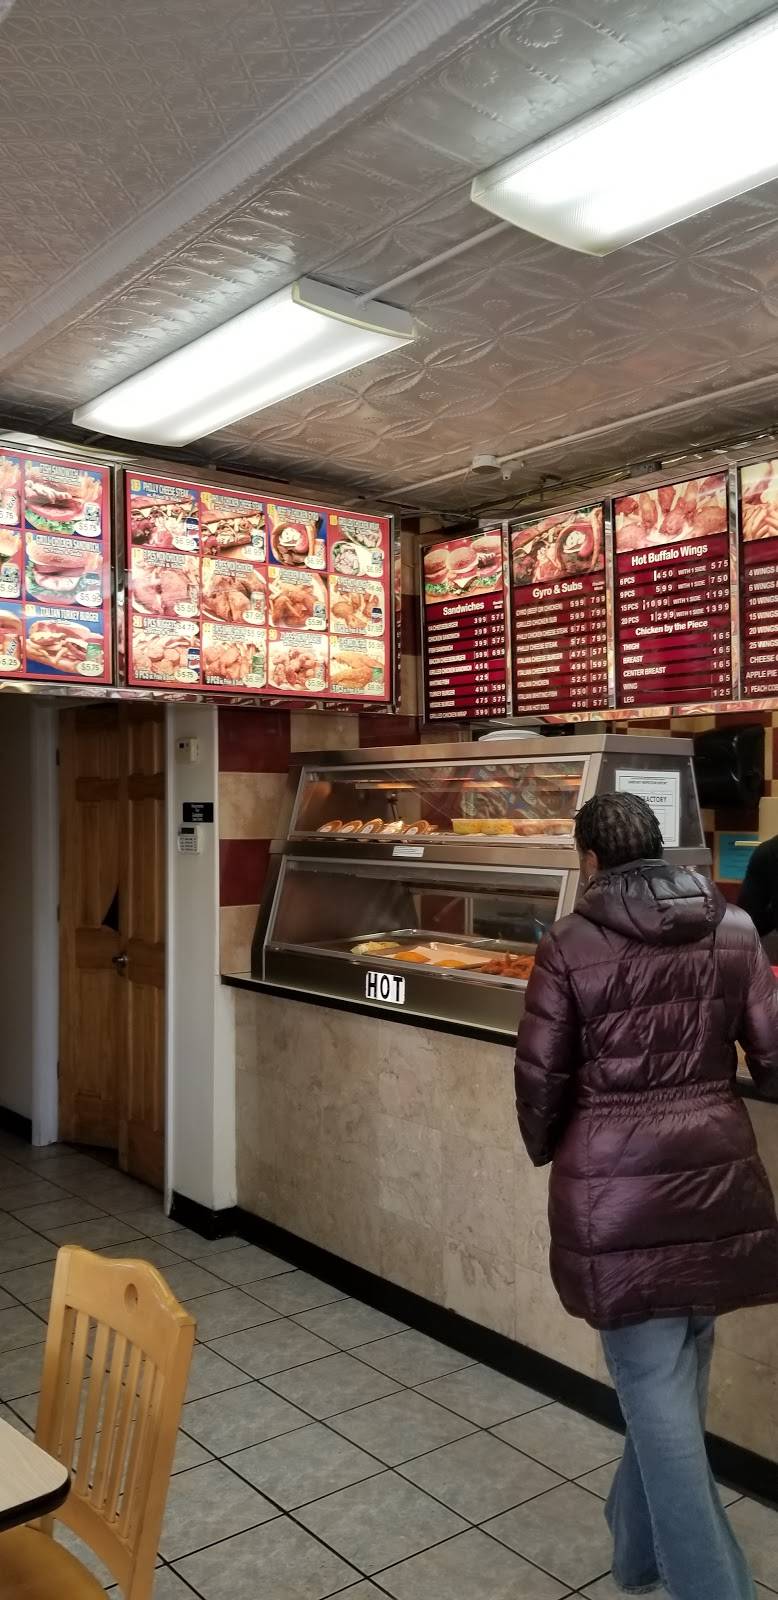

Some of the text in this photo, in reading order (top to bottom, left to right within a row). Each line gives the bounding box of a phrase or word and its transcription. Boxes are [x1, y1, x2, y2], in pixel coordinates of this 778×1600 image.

[631, 544, 708, 567] Hot Buffalo Wings
[624, 576, 635, 584] PCS
[656, 570, 673, 580] 450
[678, 568, 691, 576] WITH
[694, 565, 706, 573] SIDE
[711, 560, 729, 570] 575
[753, 566, 775, 576] WINGS
[532, 581, 583, 599] Gyro & Subs
[624, 590, 635, 598] PCS
[656, 584, 673, 593] 599
[678, 582, 690, 590] WITH
[694, 579, 706, 587] SIDE
[711, 574, 728, 584] 750
[753, 581, 775, 591] WINGS
[627, 602, 639, 611] PCS
[646, 598, 668, 608] 1099
[673, 597, 685, 605] WITH
[689, 594, 701, 602] SIDE
[706, 589, 730, 599] 1199
[749, 595, 778, 606] 10 WINGS
[443, 602, 485, 616] Sandwiches
[570, 611, 585, 620] 599
[621, 617, 628, 625] 20
[628, 615, 640, 624] PCS
[650, 611, 674, 622] 1299
[692, 607, 705, 615] SIDE
[706, 603, 730, 613] 1399
[749, 610, 778, 620] 15 WINGS
[635, 620, 709, 636] Chicken by the Piece
[749, 624, 778, 635] 20 WINGS
[570, 637, 586, 646] 575
[622, 632, 730, 651] THIGH 165
[749, 639, 778, 650] 25 WINGS
[623, 646, 730, 665] BREAST 165
[749, 655, 775, 664] CHEESE
[623, 659, 730, 677] CENTER BREAST 165
[746, 669, 778, 679] APPLE PIE
[571, 675, 587, 683] 525
[623, 674, 730, 690] WING 85
[750, 684, 767, 693] PEACH
[493, 695, 506, 703] 575
[623, 688, 731, 704] LEG 125
[367, 971, 404, 1002] HOT
